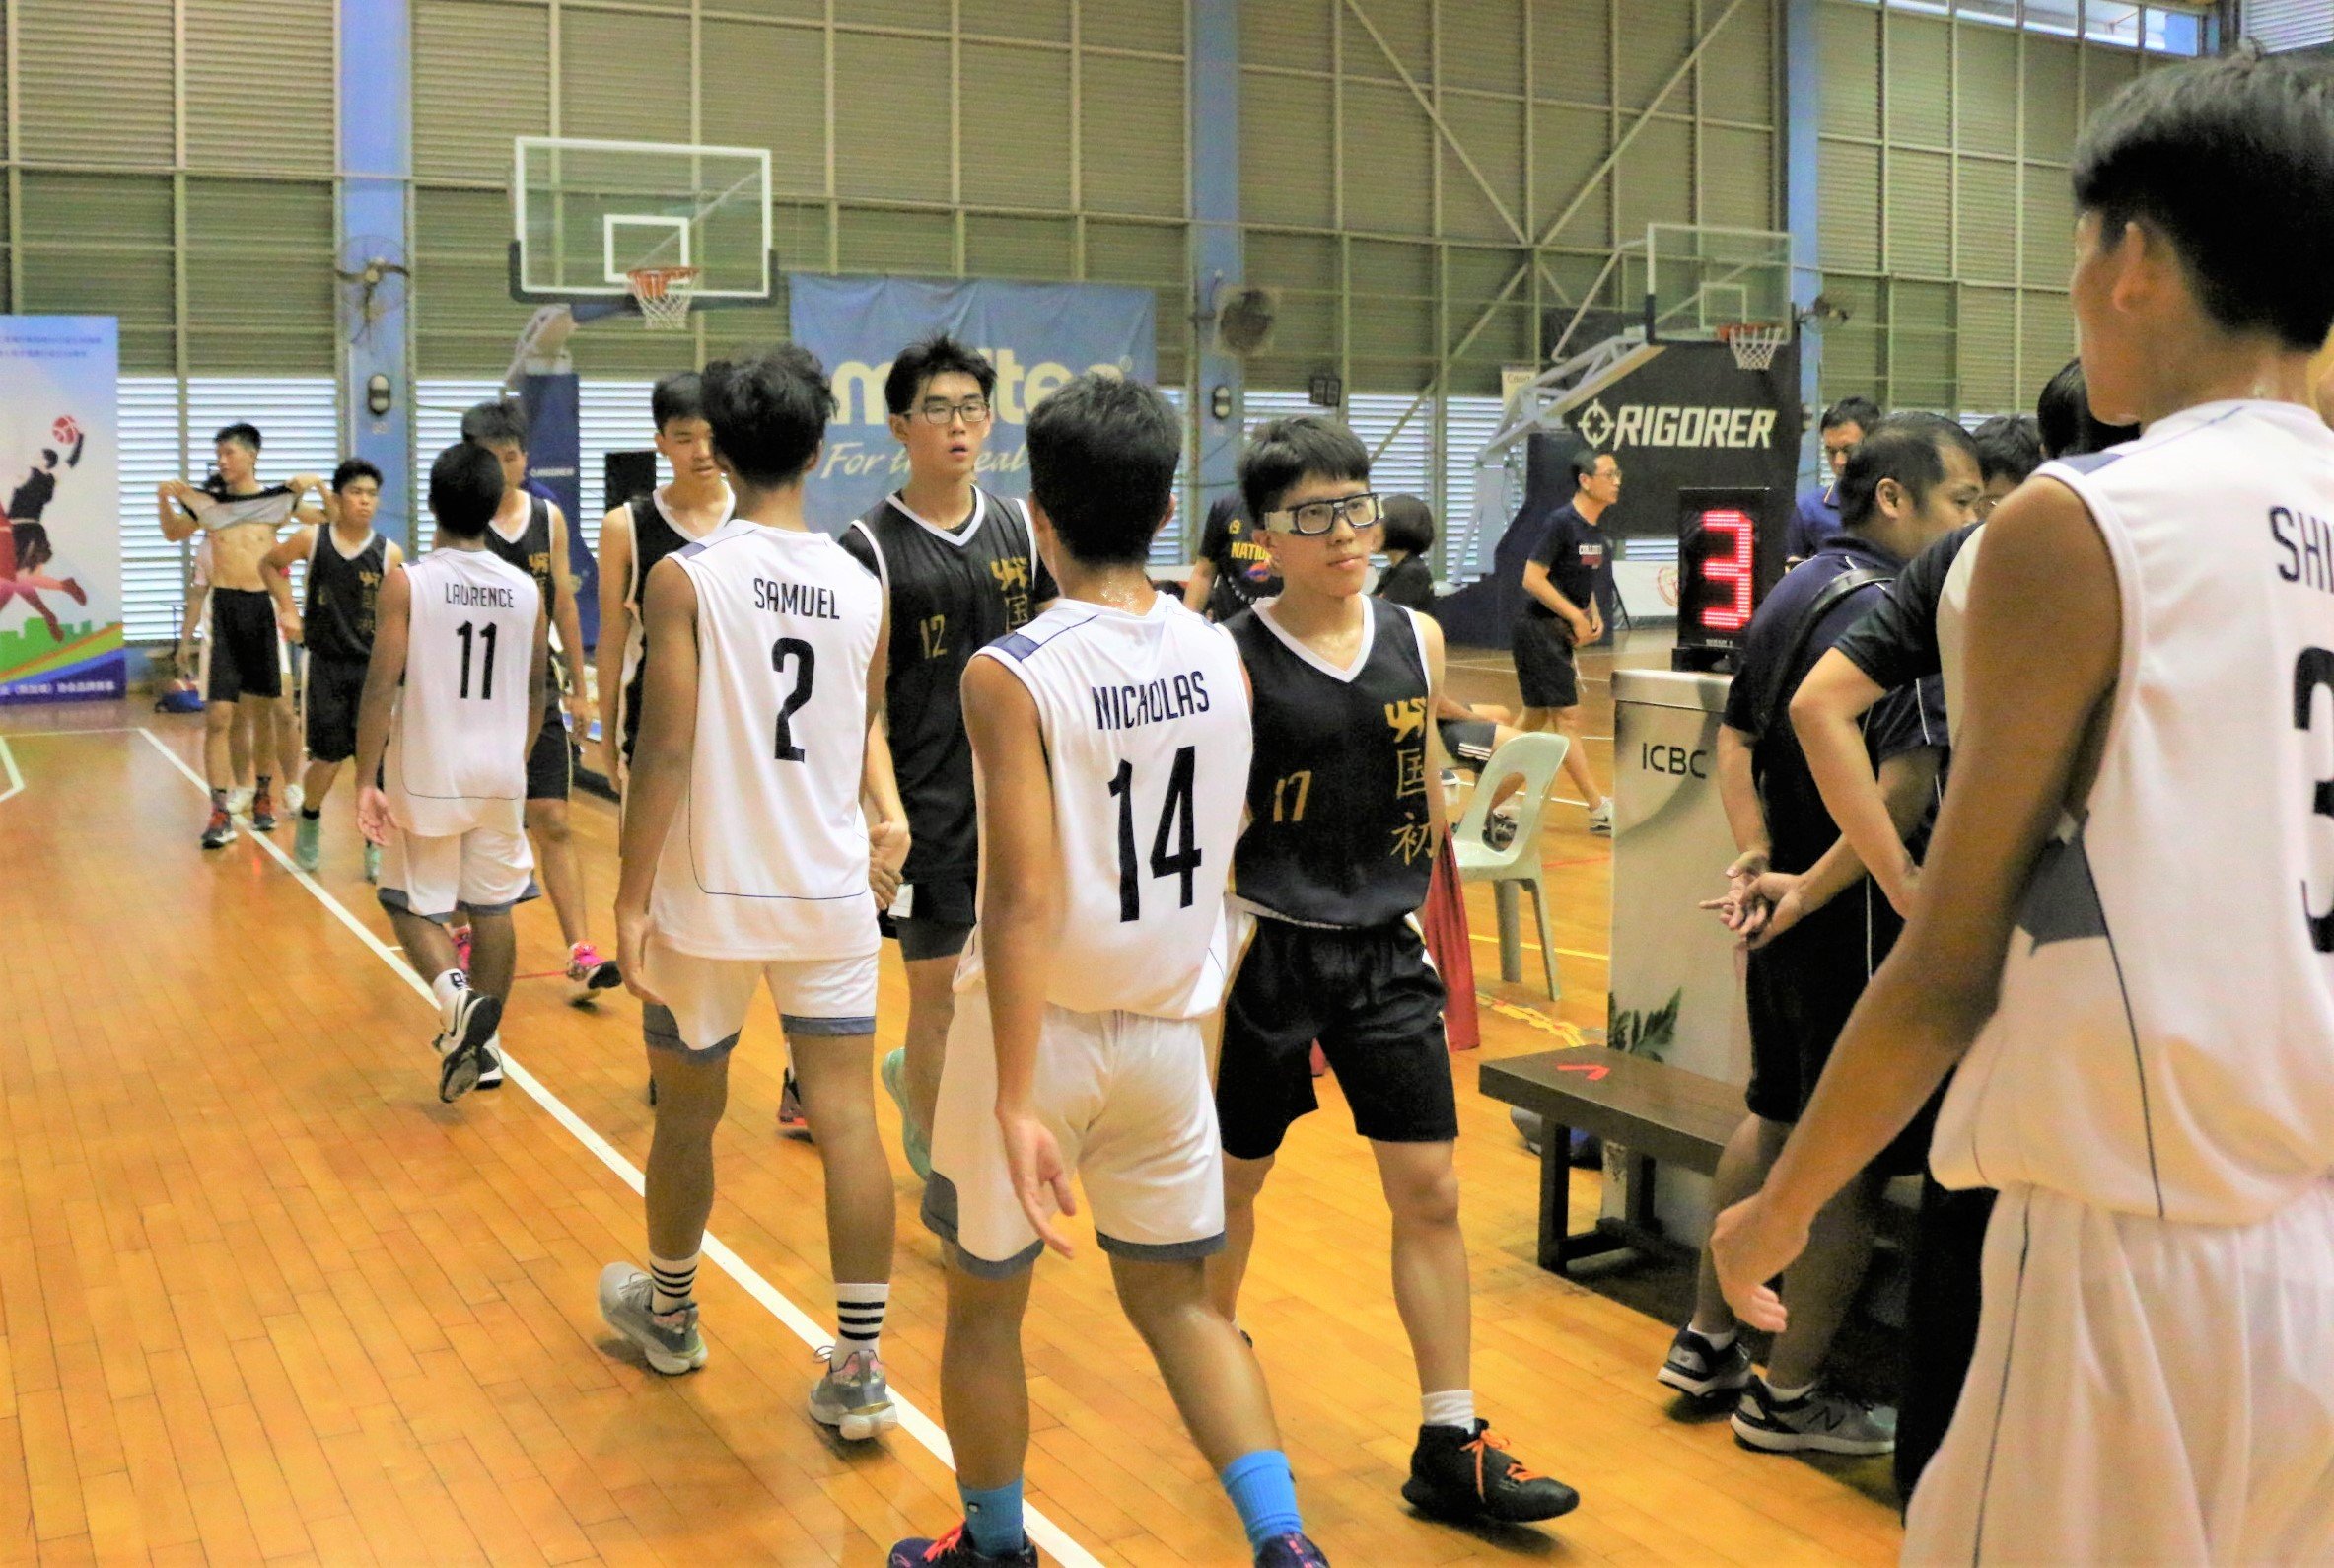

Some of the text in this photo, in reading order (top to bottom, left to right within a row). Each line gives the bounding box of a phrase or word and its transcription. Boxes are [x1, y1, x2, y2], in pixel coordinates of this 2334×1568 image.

[1612, 404, 1777, 451] RIGORER
[820, 442, 885, 479] For
[973, 442, 1026, 473] eal
[1700, 509, 1753, 629] 3
[445, 582, 515, 608] LAURENCE
[753, 577, 840, 620] SAMUEL
[456, 620, 497, 700] 11
[920, 614, 948, 660] 12
[771, 637, 814, 763] 2
[1092, 671, 1210, 730] NICHOLAS
[1643, 742, 1707, 779] ICBC
[1273, 770, 1312, 822] 17
[1107, 746, 1202, 923] 14
